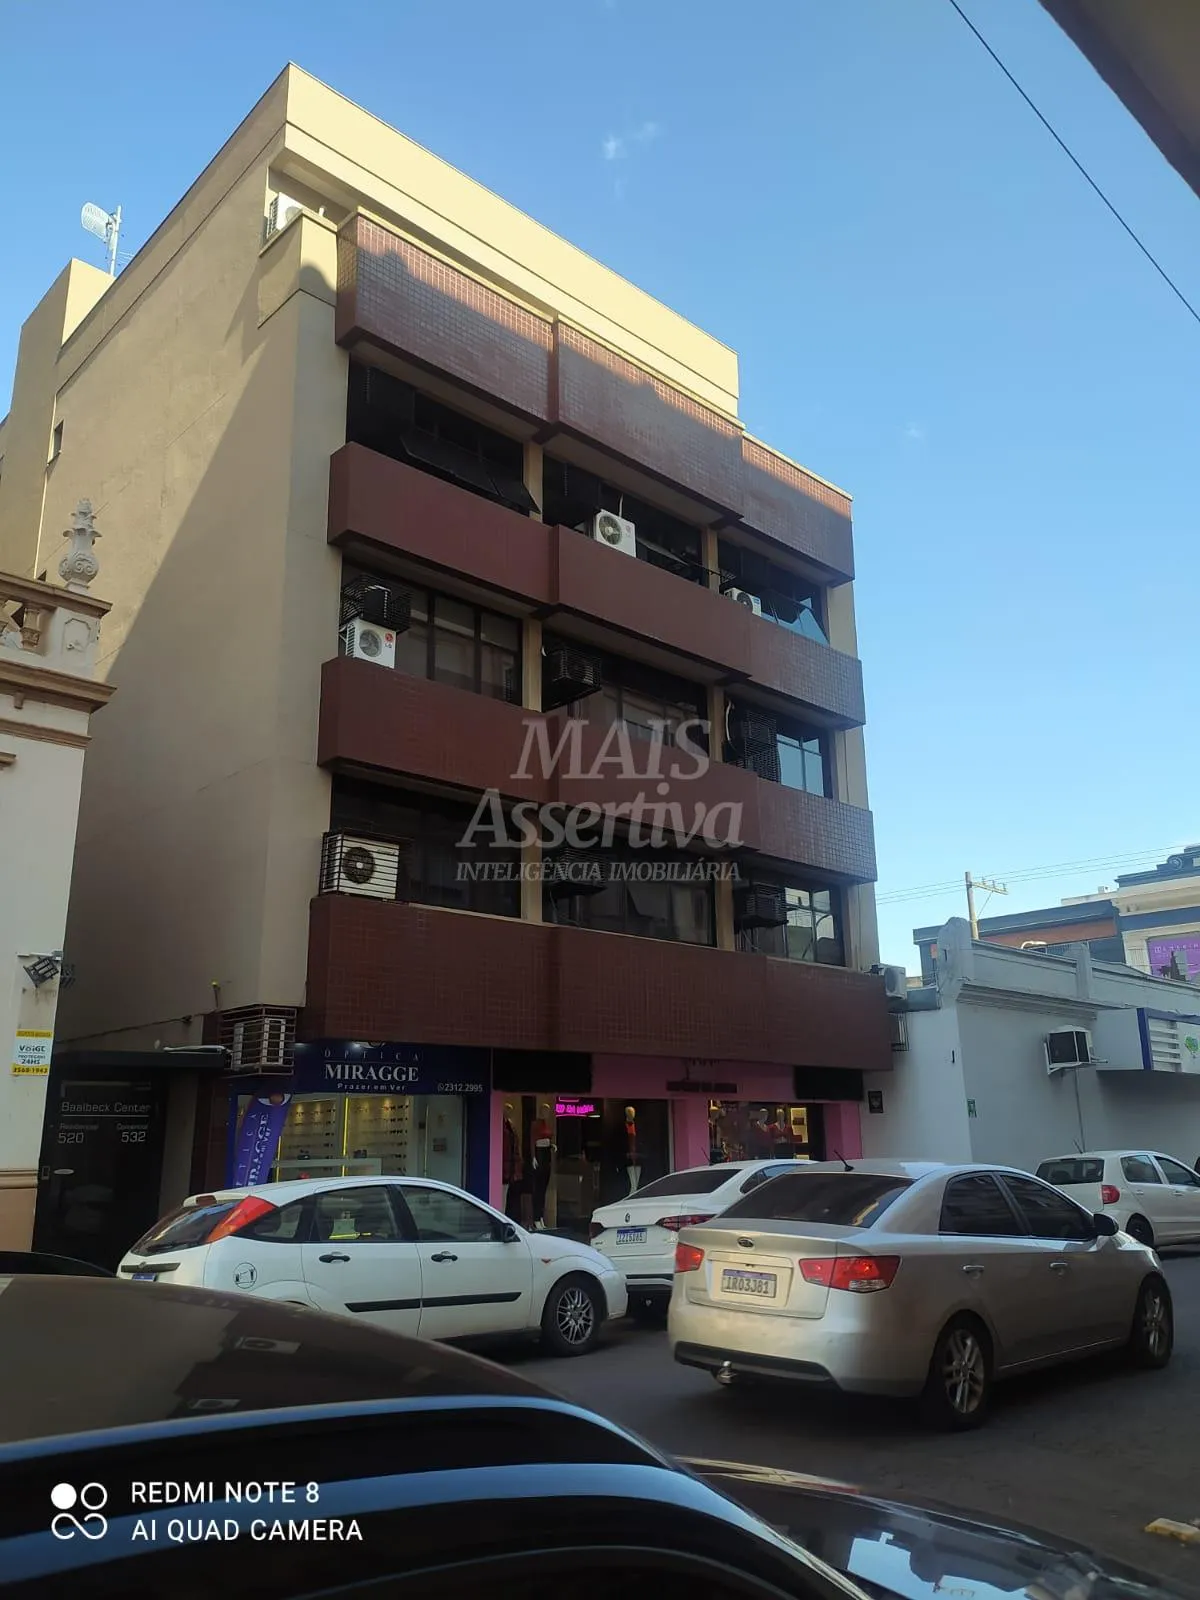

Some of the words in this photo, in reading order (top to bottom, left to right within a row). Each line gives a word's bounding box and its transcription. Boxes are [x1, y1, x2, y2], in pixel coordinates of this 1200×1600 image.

[325, 1063, 419, 1082] MIRAGGE
[61, 1101, 110, 1112] Baalbeck
[114, 1101, 151, 1112] Center
[57, 1132, 84, 1144] 520
[121, 1131, 146, 1143] 532
